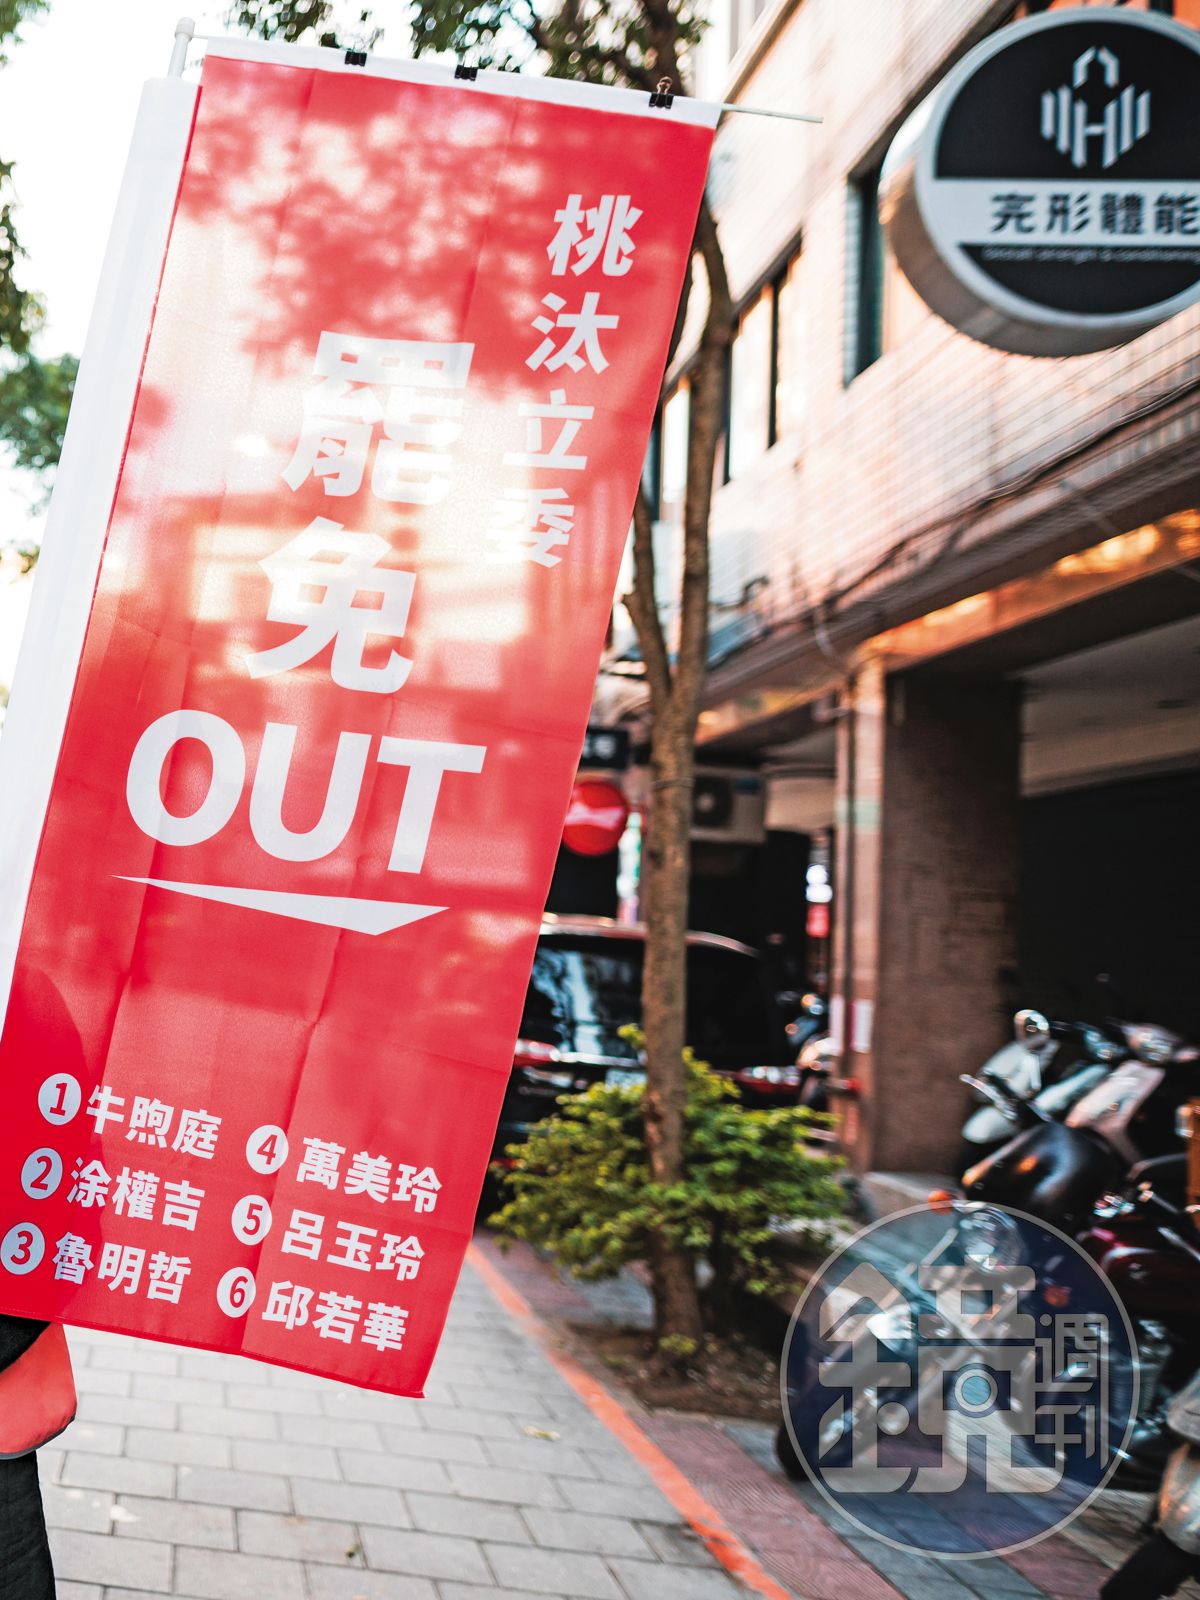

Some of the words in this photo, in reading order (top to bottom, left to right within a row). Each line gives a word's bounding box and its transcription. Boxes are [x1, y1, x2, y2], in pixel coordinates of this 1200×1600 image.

[486, 193, 644, 569] 桃汰立委
[244, 330, 476, 695] 罷免
[126, 708, 488, 876] OUT
[86, 1085, 223, 1160] 牛煦庭
[66, 1156, 206, 1232] 涂權吉
[296, 1137, 443, 1214] 萬美玲
[52, 1232, 193, 1305] 魯明哲
[280, 1208, 425, 1282] 呂玉玲
[261, 1279, 410, 1353] 邱若華
